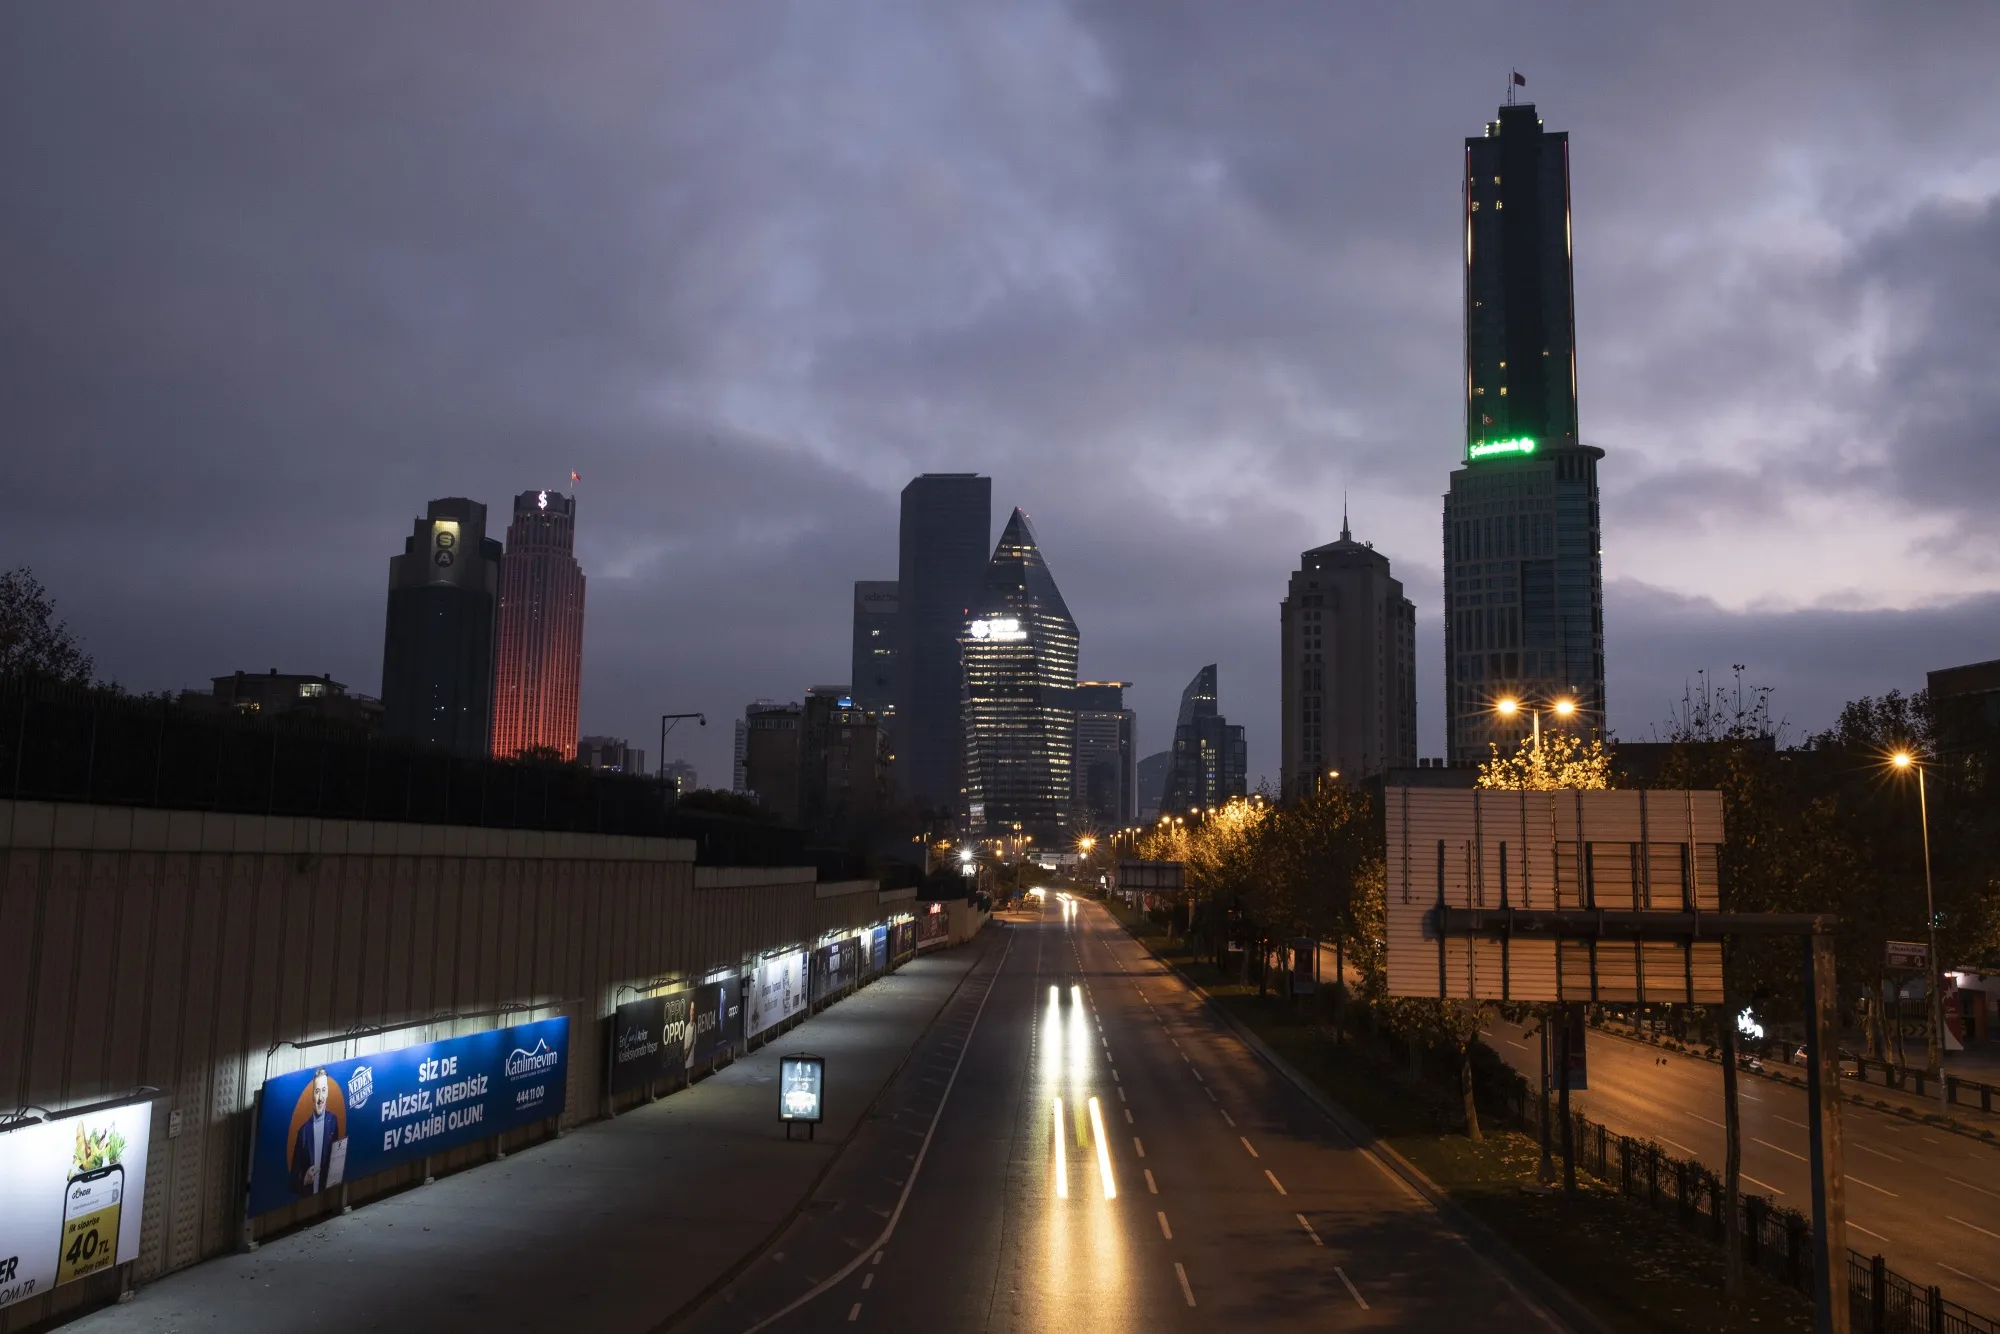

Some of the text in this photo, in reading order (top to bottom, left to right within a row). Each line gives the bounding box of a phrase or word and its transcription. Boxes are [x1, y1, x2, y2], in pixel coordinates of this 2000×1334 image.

[664, 998, 686, 1023] OPPO
[663, 1020, 685, 1046] OPPO
[418, 1056, 458, 1083] SİZ DE
[348, 1070, 373, 1097] NEDEN
[516, 1089, 529, 1104] 444
[536, 1085, 545, 1098] 00
[381, 1089, 433, 1122] FAİZSİZ,
[435, 1073, 488, 1106] KREDİSİZ
[383, 1103, 484, 1151] EV SAHİBİ OLUN!
[77, 1216, 100, 1232] siparişe
[66, 1228, 110, 1266] 40 TL
